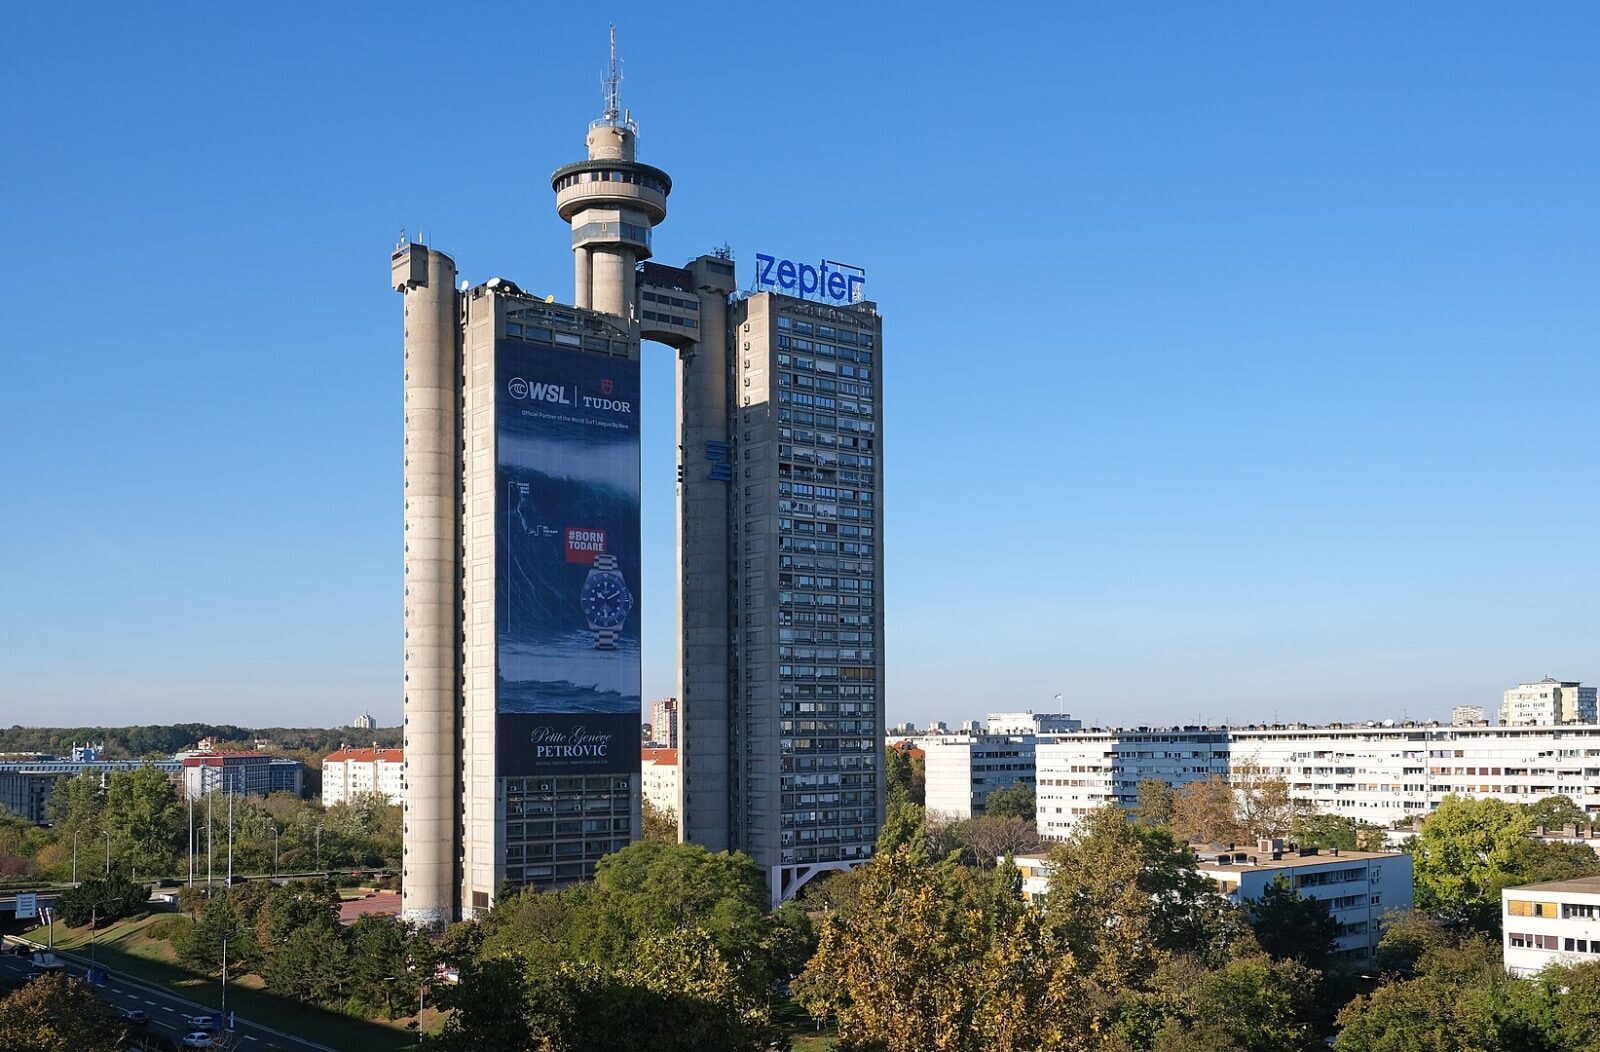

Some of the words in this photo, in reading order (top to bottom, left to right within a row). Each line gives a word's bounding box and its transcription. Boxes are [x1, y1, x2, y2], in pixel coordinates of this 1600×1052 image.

[756, 253, 865, 303] zepter
[529, 382, 570, 404] WSL
[583, 396, 631, 413] TUDOR
[521, 409, 538, 417] Official
[539, 412, 557, 420] Partner
[568, 530, 604, 543] #BORN
[568, 541, 604, 551] TODARE
[530, 726, 567, 743] Petite
[536, 741, 608, 757] PETROVIĆ
